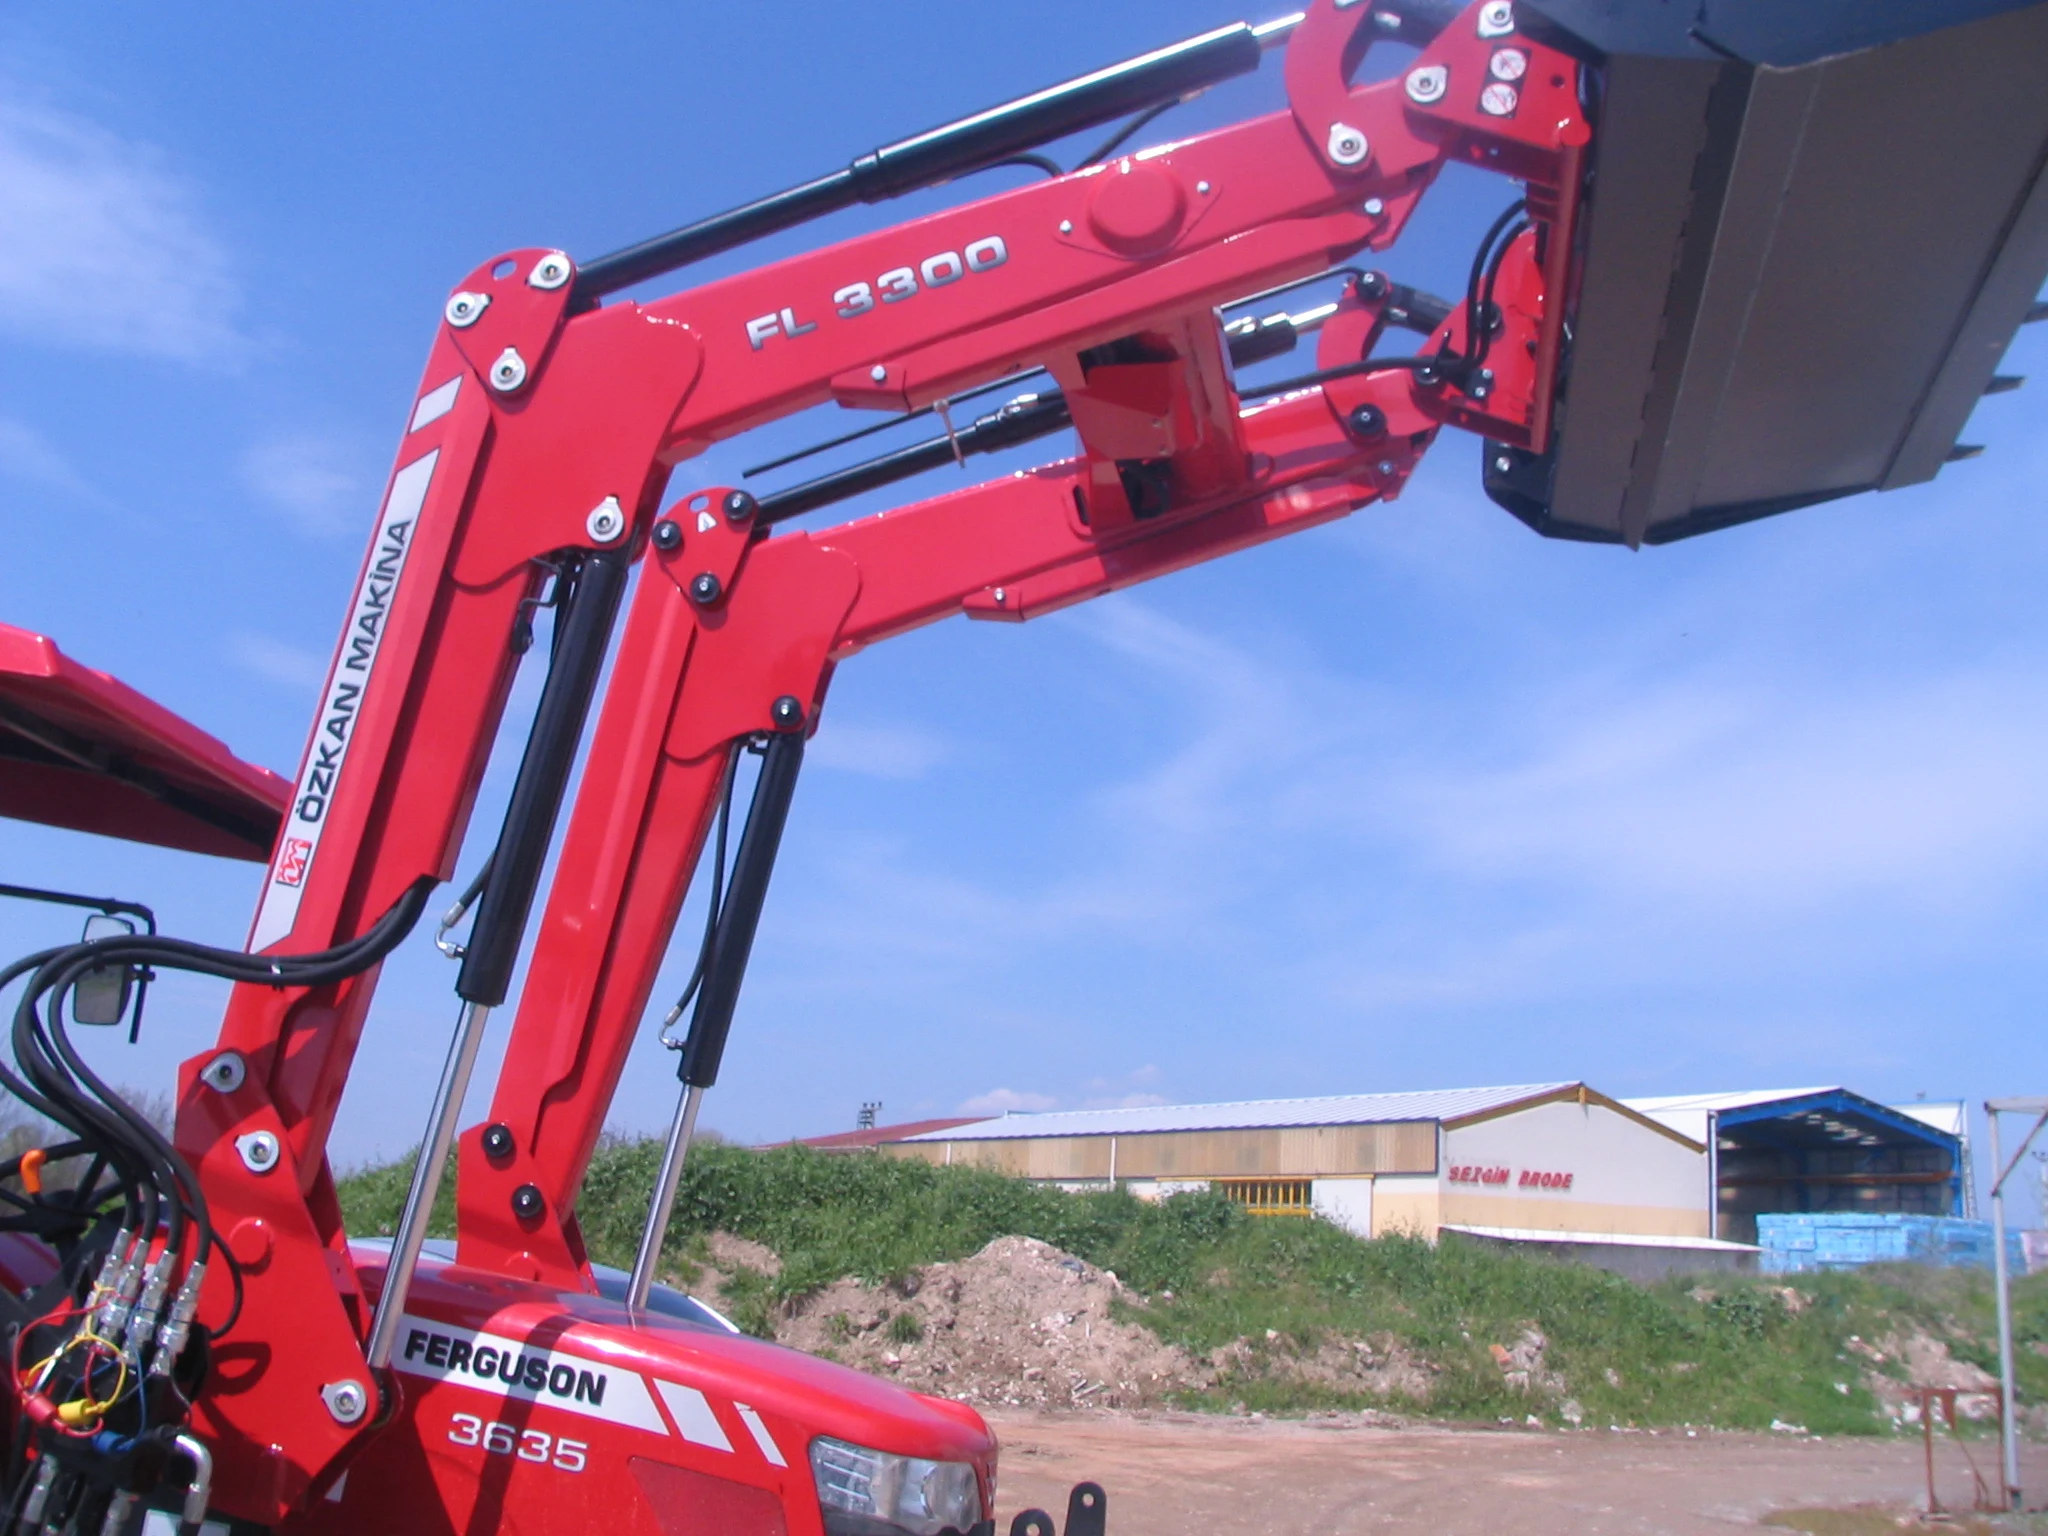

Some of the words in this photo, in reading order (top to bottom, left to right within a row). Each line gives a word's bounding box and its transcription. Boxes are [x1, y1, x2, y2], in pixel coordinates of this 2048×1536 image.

[745, 306, 818, 351] FL
[832, 234, 1009, 320] 3300
[295, 682, 361, 823] ÖZKAN
[345, 519, 412, 671] MAKİNA
[404, 1328, 607, 1406] FERGUSON
[447, 1411, 588, 1472] 3635
